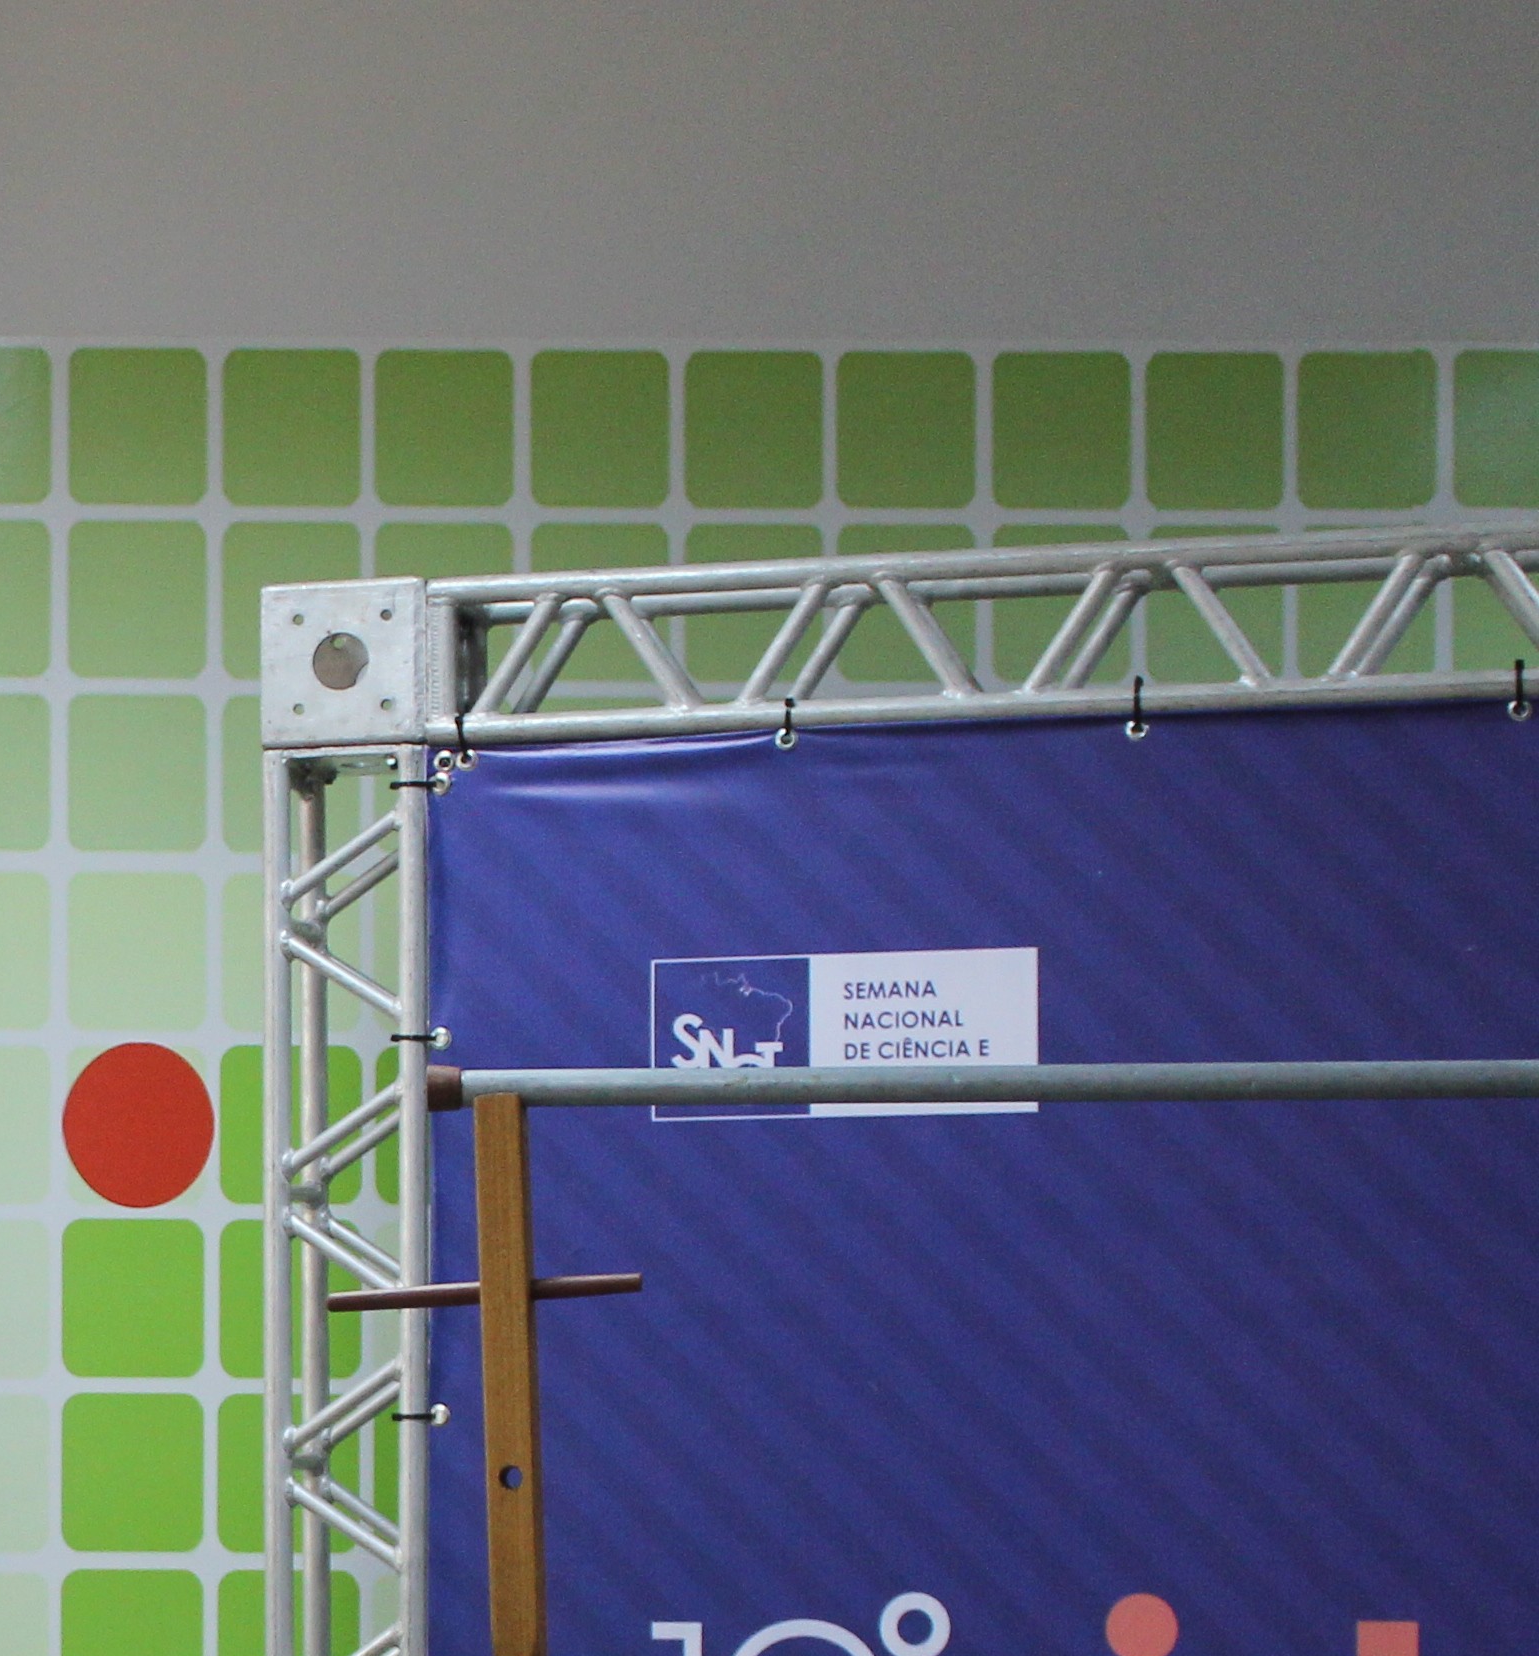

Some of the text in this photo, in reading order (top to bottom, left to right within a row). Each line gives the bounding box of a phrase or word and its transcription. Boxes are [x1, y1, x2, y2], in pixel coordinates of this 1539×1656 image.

[843, 979, 937, 1001] SEMANA
[843, 1009, 964, 1030] NACIONAL
[843, 1036, 990, 1061] DE CIÊNCIA E
